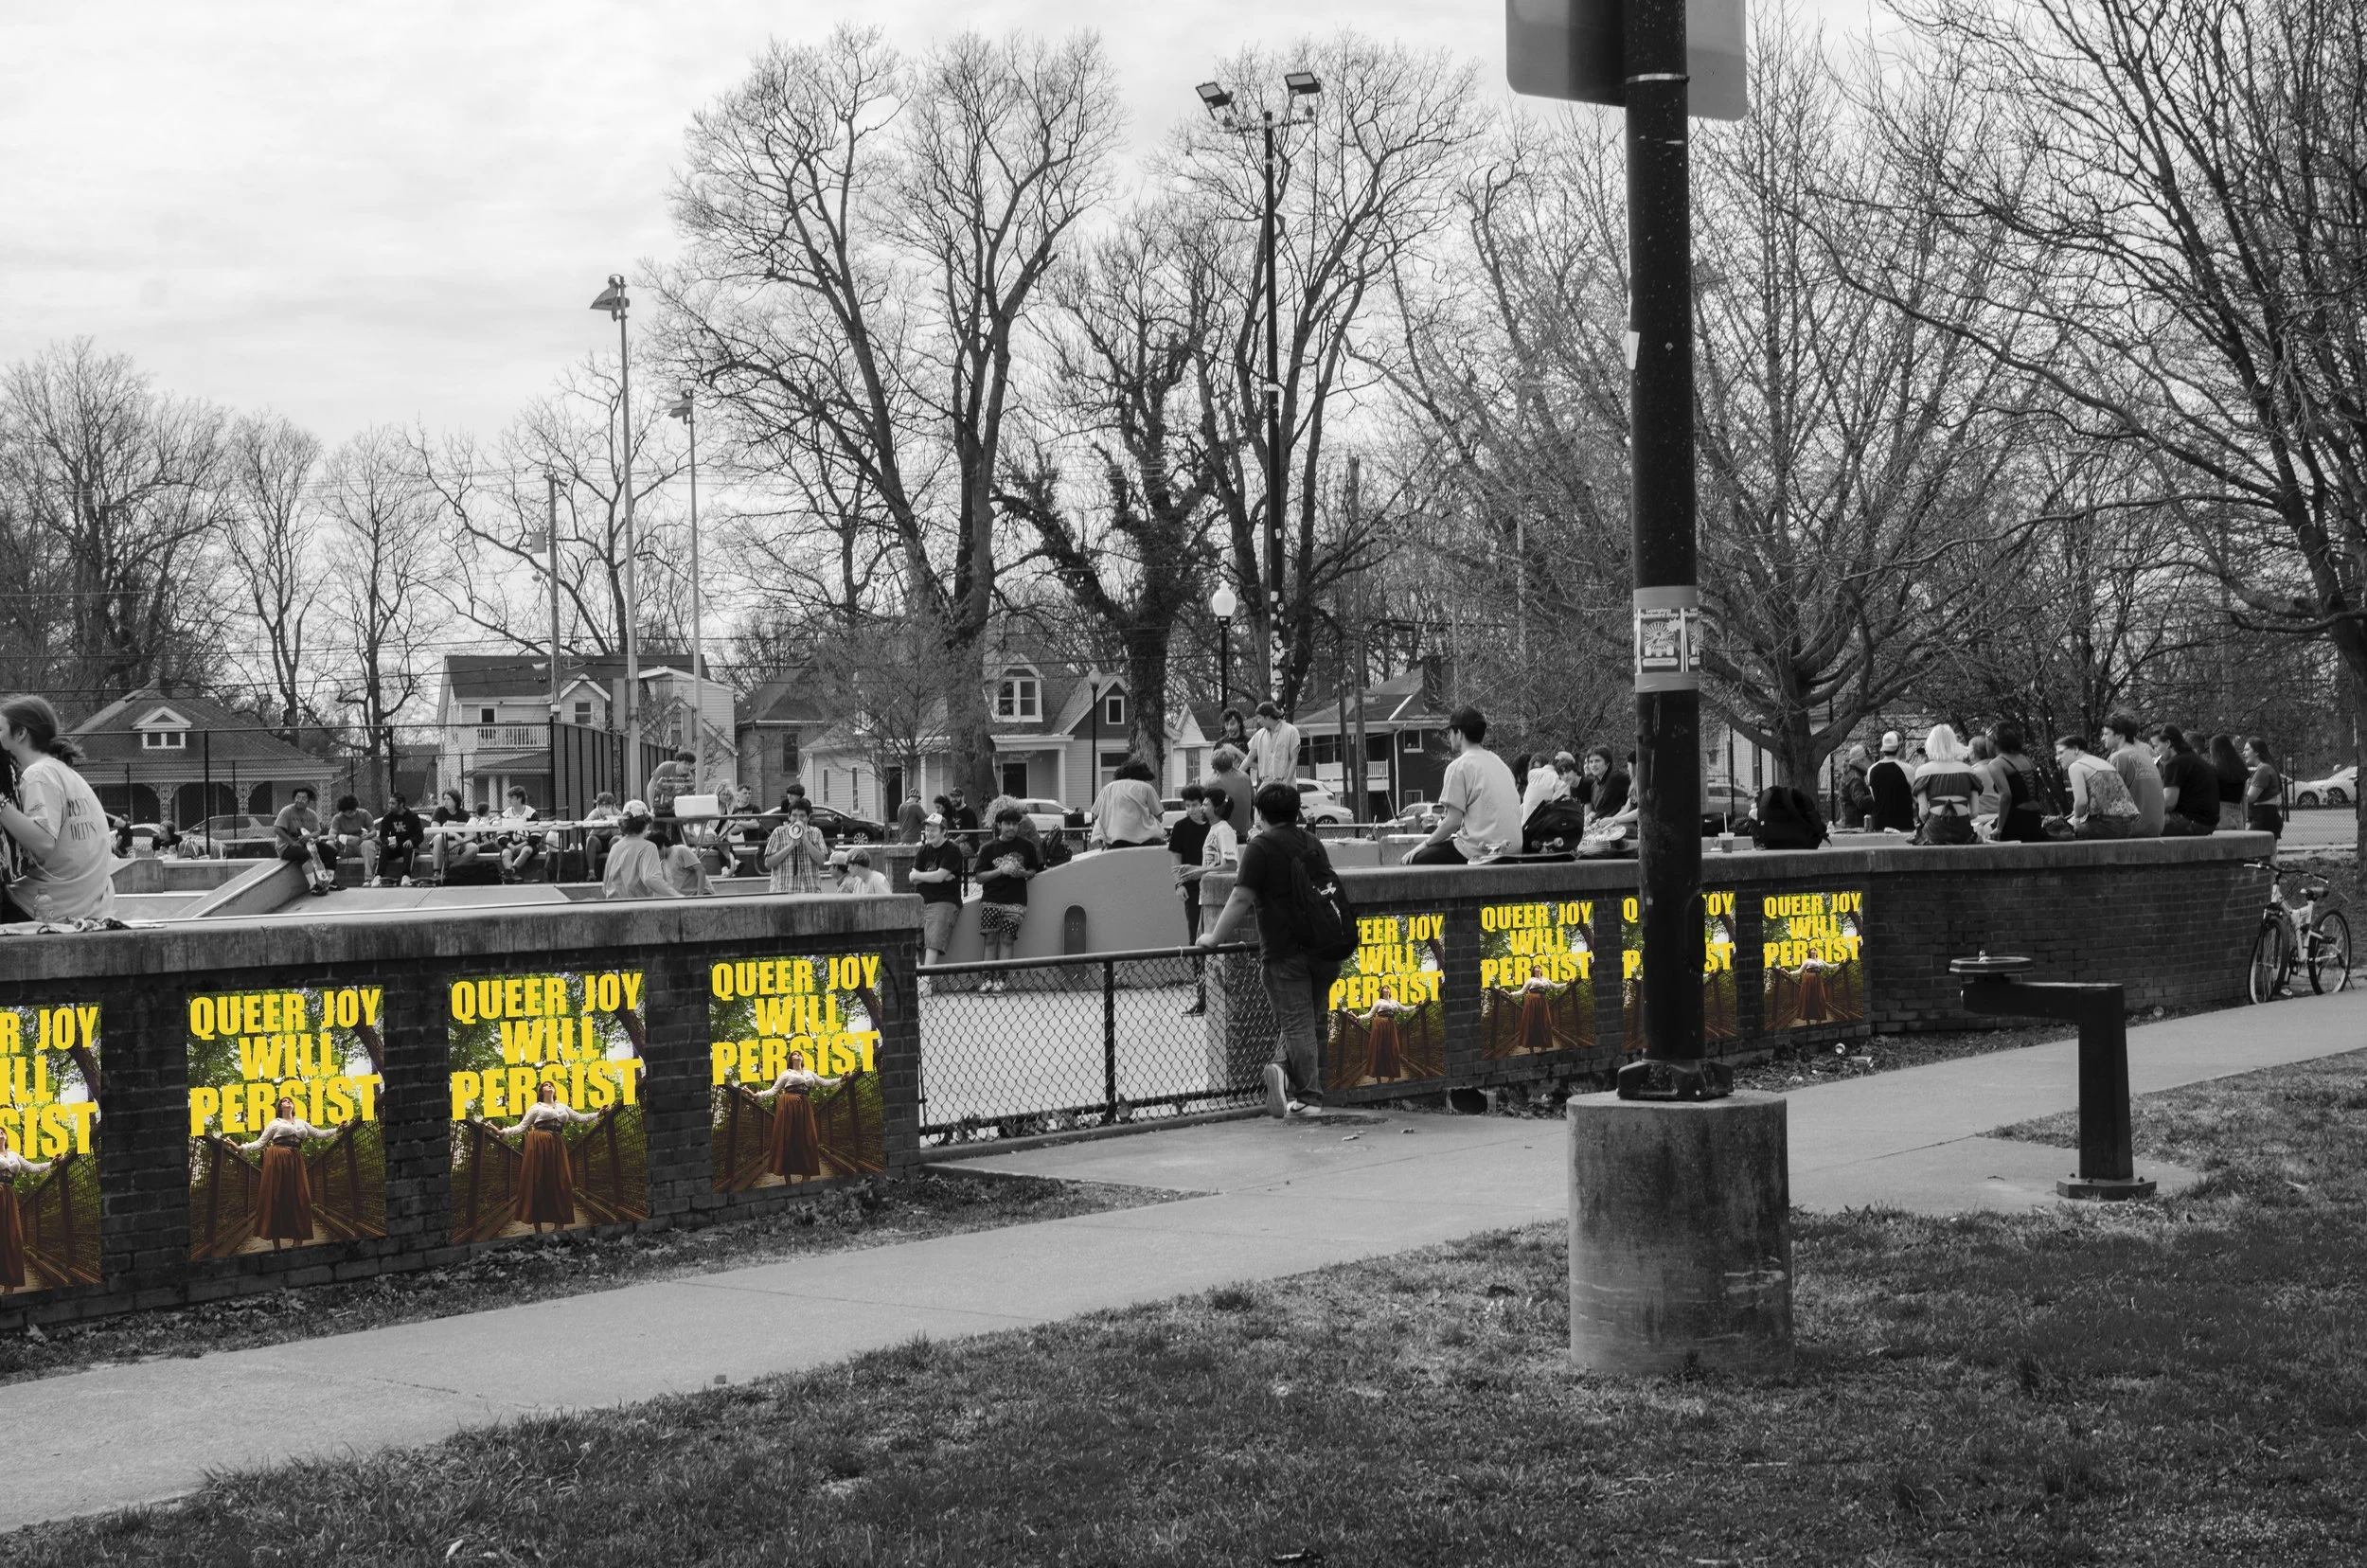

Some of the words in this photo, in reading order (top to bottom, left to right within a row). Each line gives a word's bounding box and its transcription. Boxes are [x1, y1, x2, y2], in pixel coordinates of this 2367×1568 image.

[1481, 904, 1549, 932] QUEER
[1557, 901, 1593, 925] JOY
[1702, 893, 1734, 917] OY
[1764, 894, 1823, 919] QUEER
[1831, 892, 1862, 915] JOY
[1357, 918, 1398, 945] EER
[1408, 915, 1444, 941] JOY
[1509, 928, 1568, 956] WILL
[1789, 915, 1840, 940] WILL
[1358, 943, 1418, 975] WILL
[1481, 951, 1592, 989] PERSIST
[1764, 935, 1861, 969] PERSIST
[451, 978, 567, 1025] QUEER
[582, 972, 642, 1012] JOY
[712, 962, 812, 1000] QUEER
[828, 955, 880, 990] JOY
[1328, 970, 1443, 1011] PERSIST
[36, 1007, 98, 1051] JOY
[190, 993, 305, 1041] QUEER
[321, 989, 381, 1028] JOY
[755, 994, 843, 1037] WILL
[239, 1032, 339, 1080] WILL
[500, 1017, 600, 1065] WILL
[712, 1030, 880, 1086] PERSIST
[0, 1055, 54, 1107] ILL
[451, 1059, 642, 1121] PERSIST
[190, 1074, 381, 1136] PERSIST
